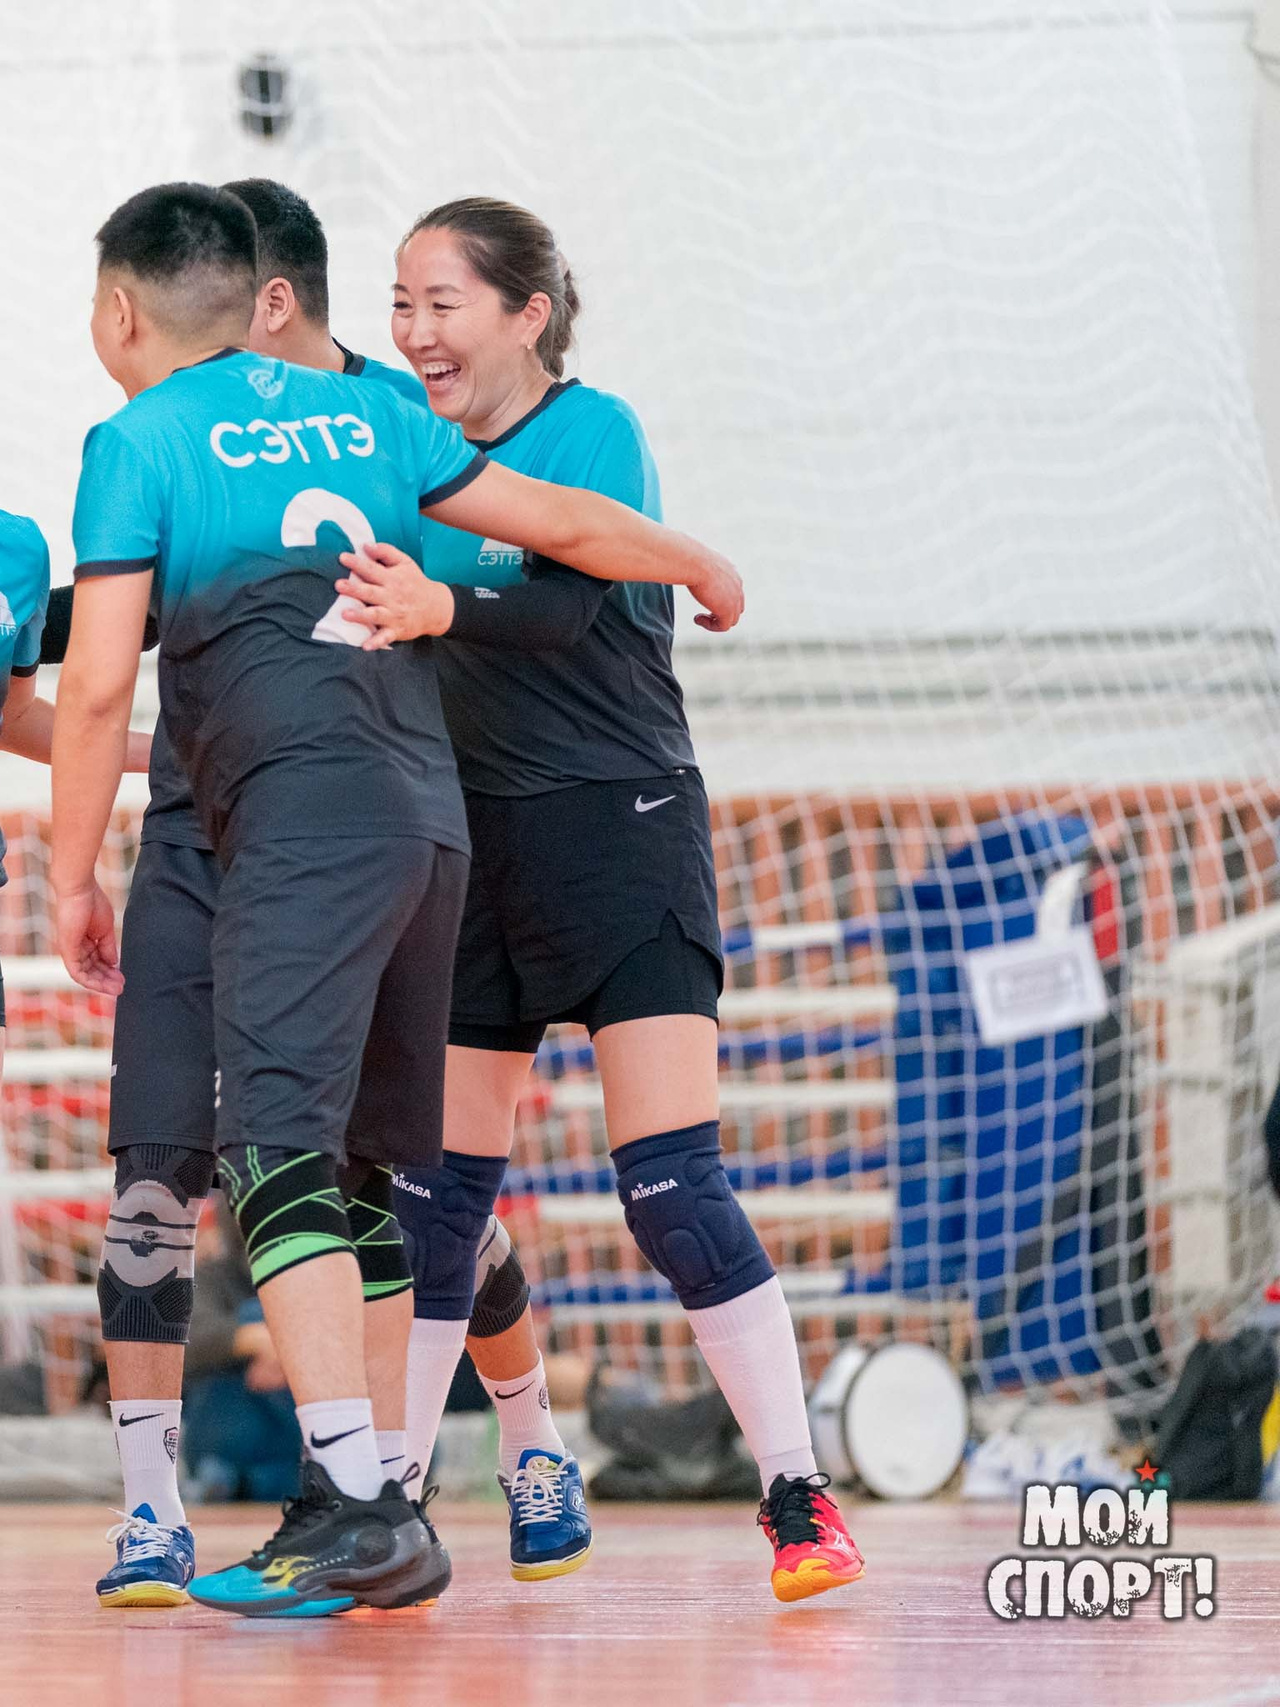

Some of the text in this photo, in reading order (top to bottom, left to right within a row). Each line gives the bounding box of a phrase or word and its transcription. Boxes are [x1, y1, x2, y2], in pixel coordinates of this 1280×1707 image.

[210, 413, 376, 468] СЭТТЭ
[280, 487, 394, 651] 2
[477, 551, 524, 566] СЭТТЭ
